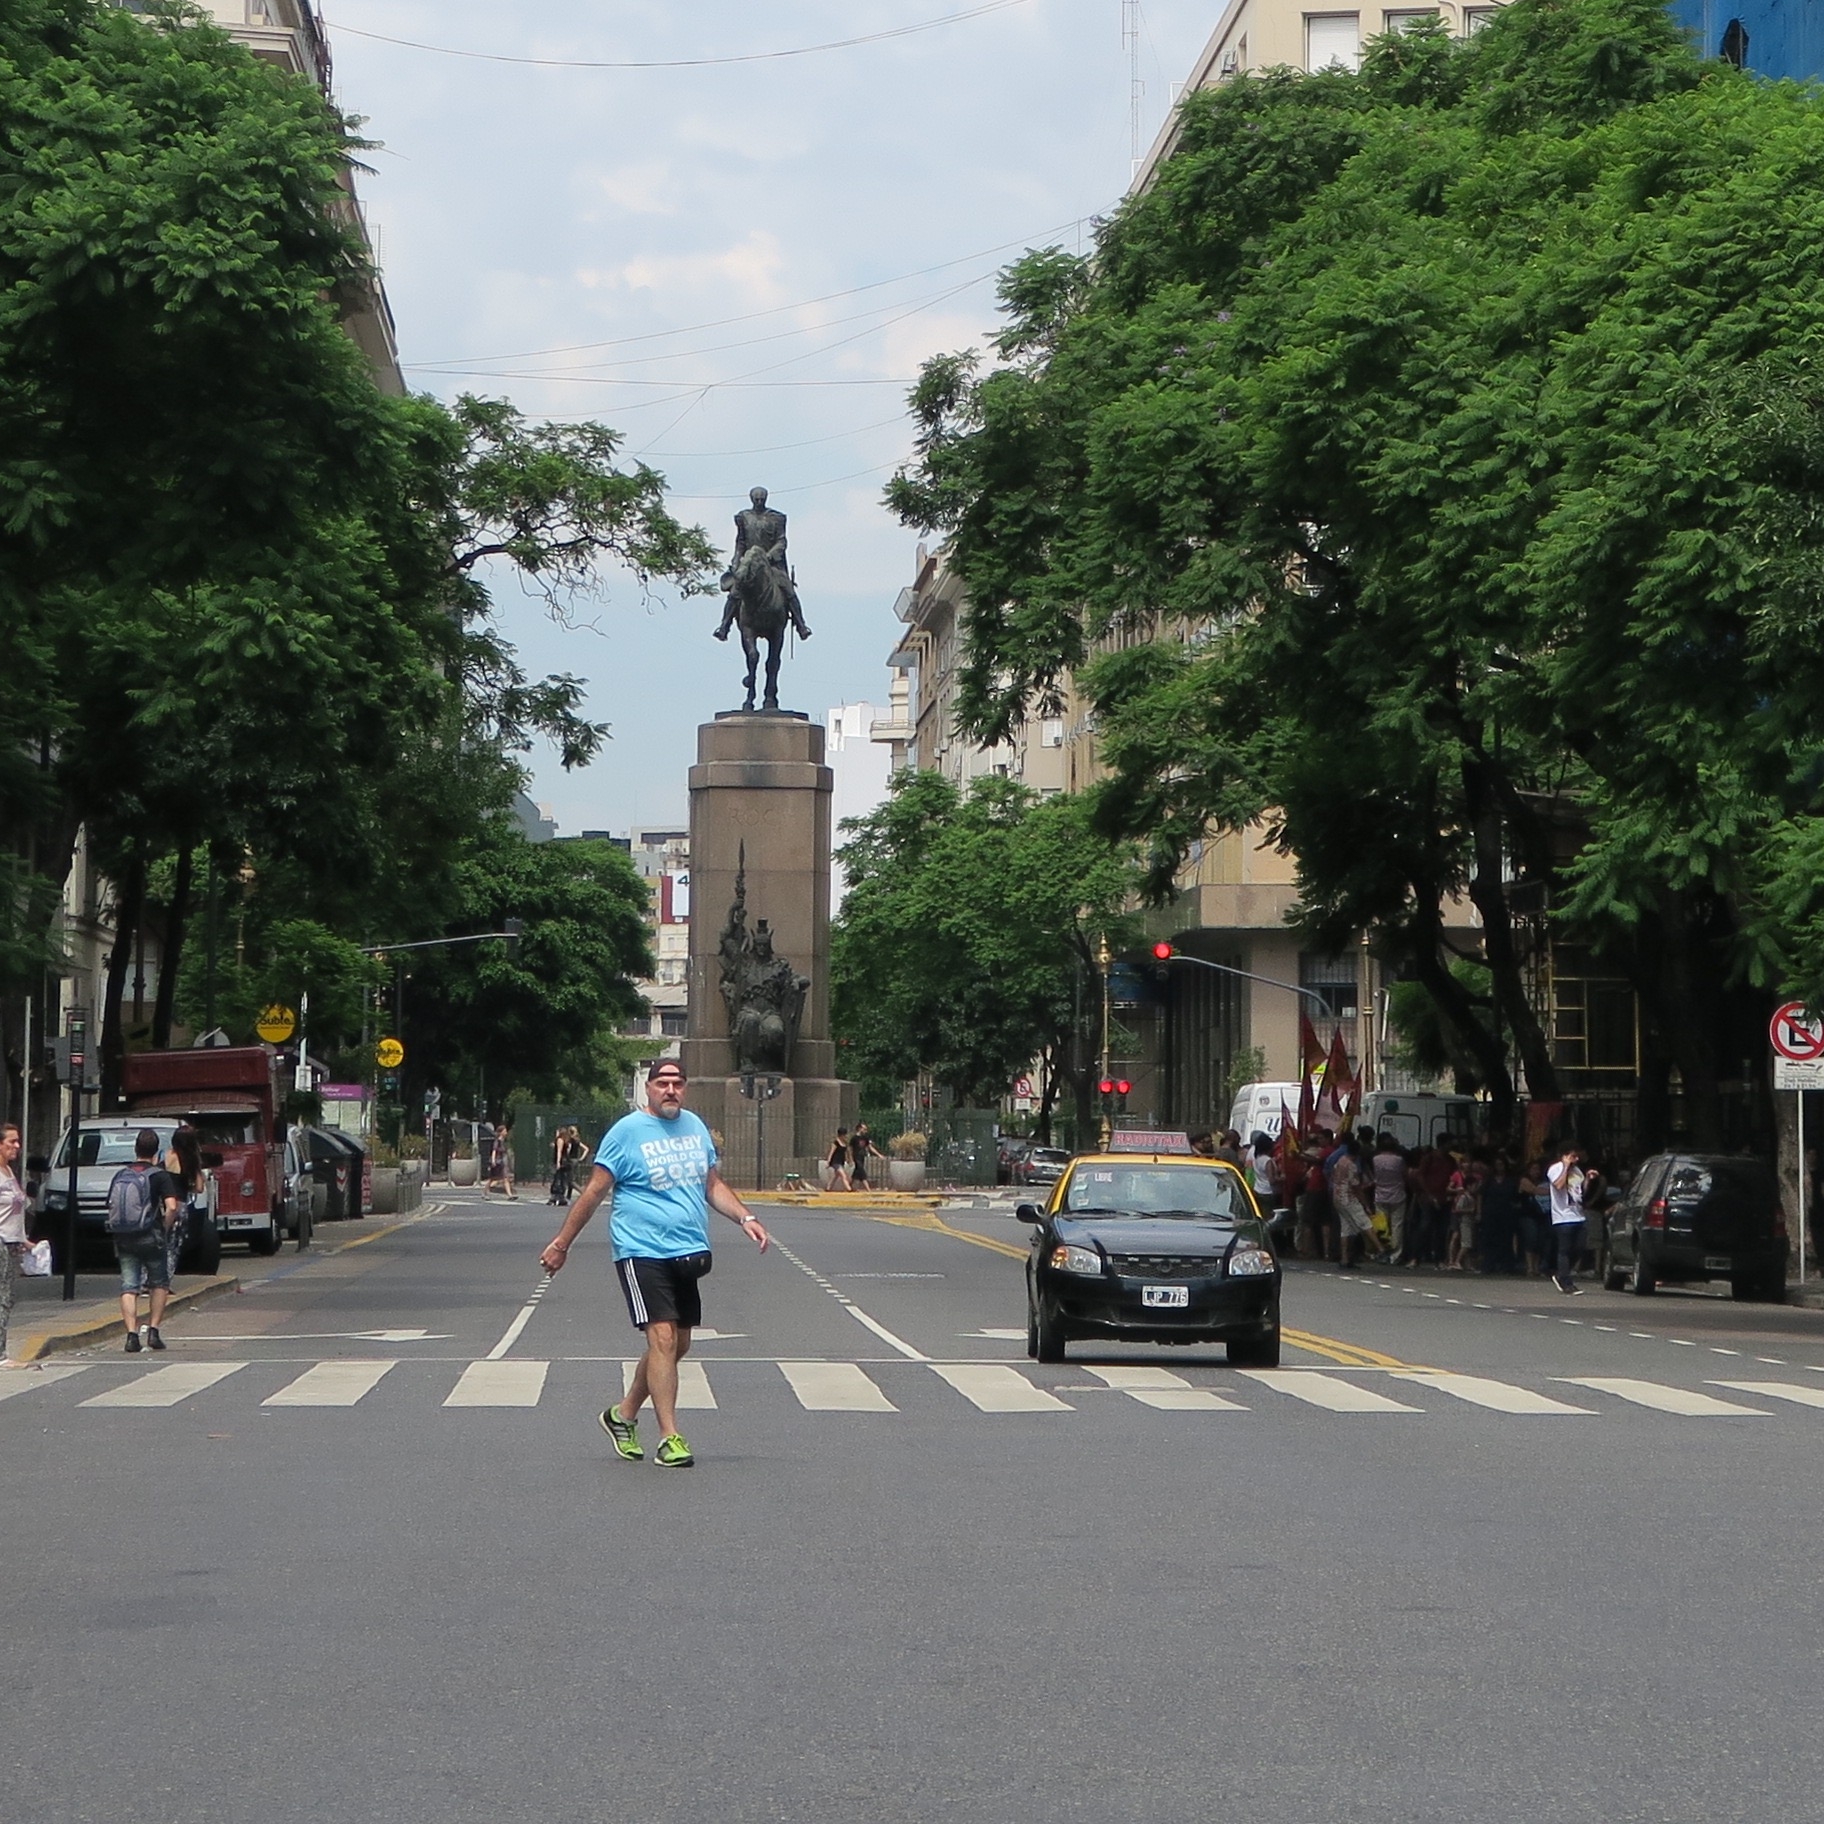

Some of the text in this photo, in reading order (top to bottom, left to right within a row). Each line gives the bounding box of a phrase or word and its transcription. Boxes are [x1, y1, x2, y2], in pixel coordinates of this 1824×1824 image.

[640, 1136, 702, 1158] RUGBY
[1114, 1133, 1186, 1147] RADIOTAXI
[645, 1153, 687, 1167] WORLD
[648, 1160, 708, 1183] 2011
[1144, 1292, 1187, 1304] LJP 776
